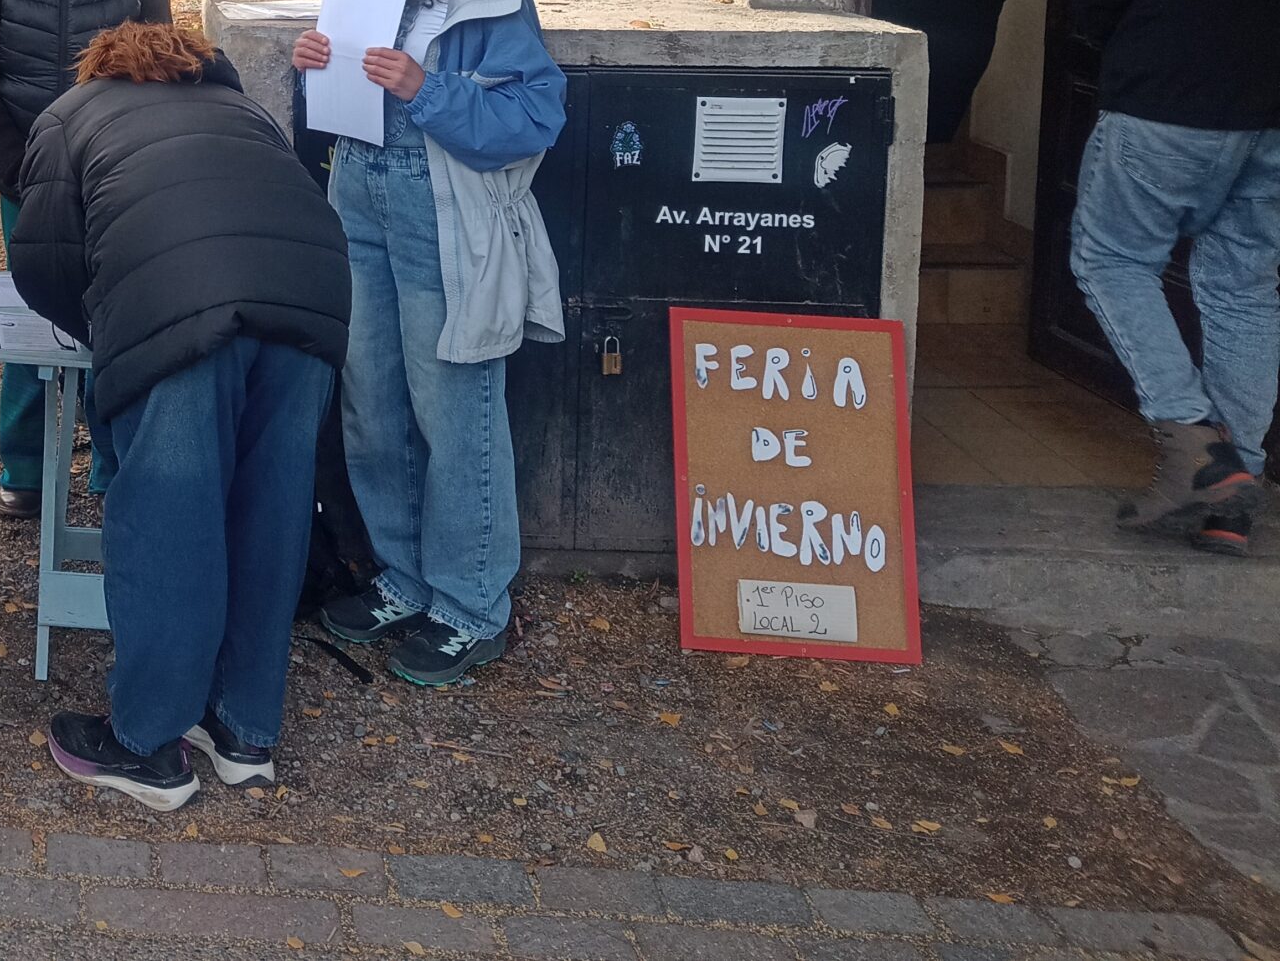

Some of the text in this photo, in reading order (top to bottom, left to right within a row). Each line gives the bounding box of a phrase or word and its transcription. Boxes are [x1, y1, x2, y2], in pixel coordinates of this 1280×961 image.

[615, 150, 640, 167] FAZ
[655, 205, 815, 230] Av. Arrayanes
[737, 236, 762, 254] 21
[751, 427, 813, 467] DE
[753, 614, 828, 635] LOCAL 2
